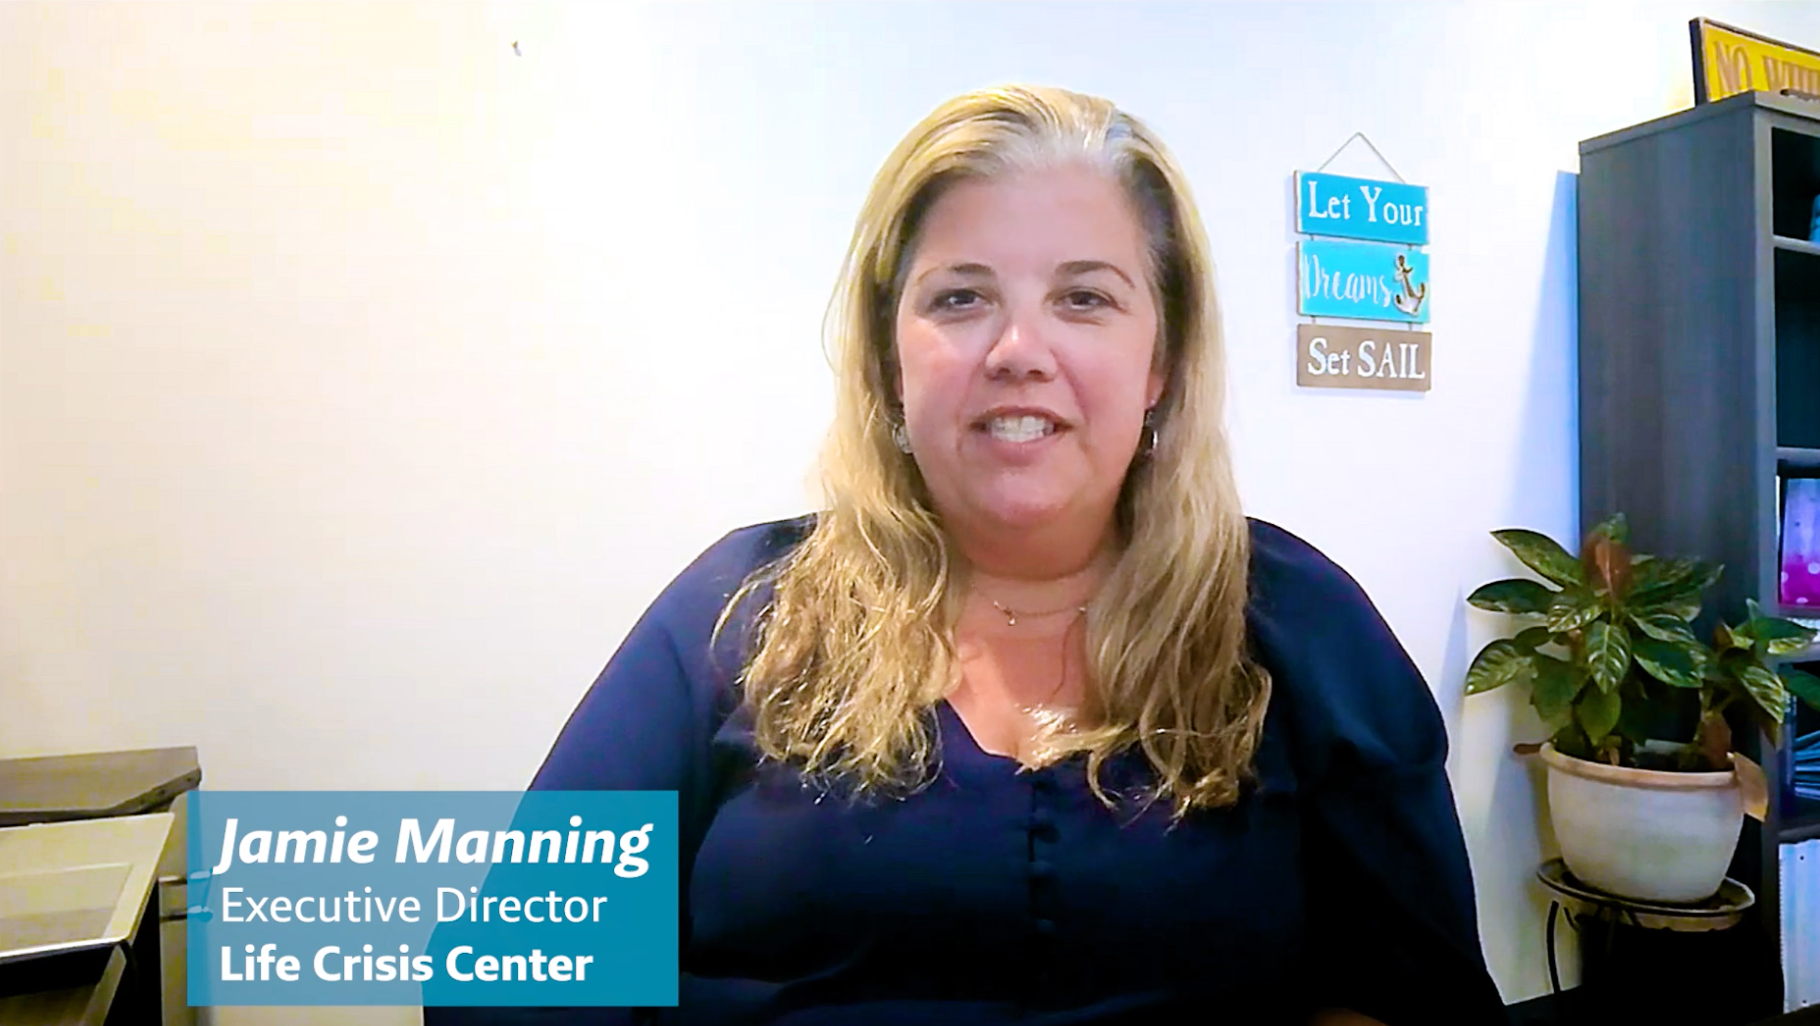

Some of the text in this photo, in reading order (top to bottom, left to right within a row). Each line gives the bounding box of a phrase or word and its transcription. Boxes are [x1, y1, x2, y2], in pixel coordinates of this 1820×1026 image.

[1712, 39, 1753, 98] NO
[1308, 180, 1424, 227] Let Your
[1304, 254, 1392, 308] Dreams
[1307, 337, 1426, 379] Set SAIL
